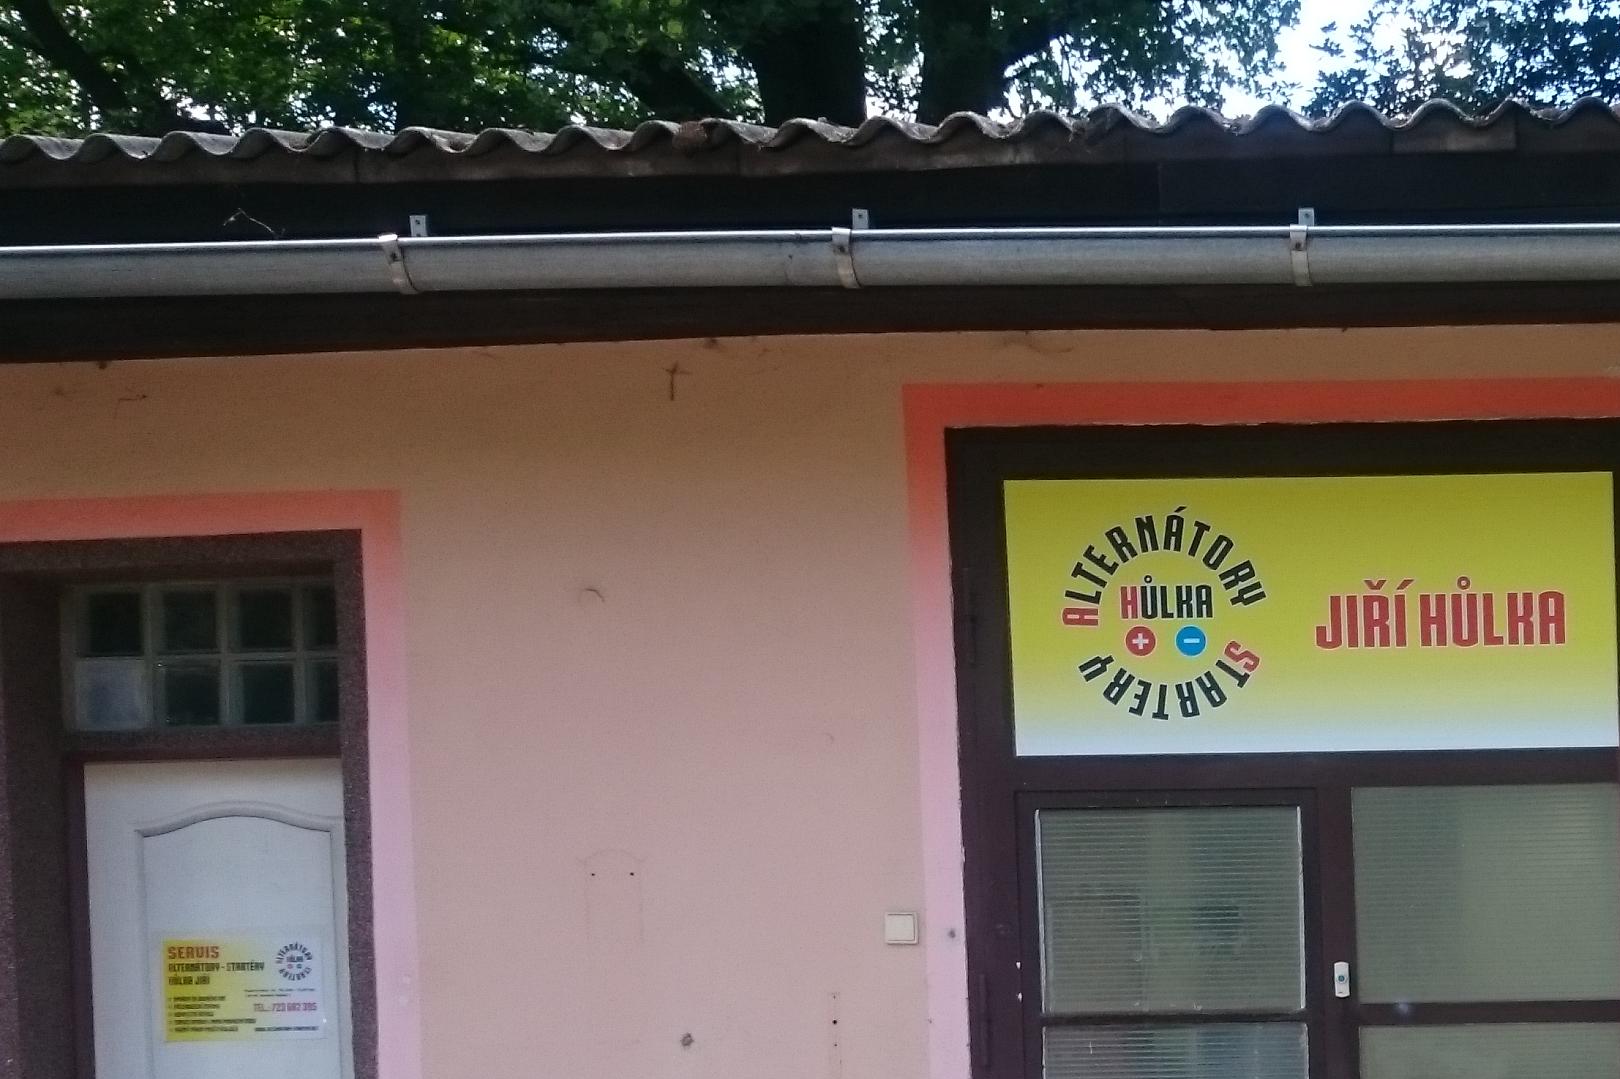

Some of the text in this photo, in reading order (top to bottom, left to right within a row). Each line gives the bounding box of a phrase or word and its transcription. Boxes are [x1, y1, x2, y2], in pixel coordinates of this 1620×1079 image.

[1062, 505, 1267, 626] ALTERNÁTORY
[1120, 575, 1213, 619] HŮLKA
[1315, 576, 1566, 649] JIŘÍ HŮLKA
[1078, 640, 1260, 720] STARTERY
[168, 945, 220, 960] SERVIS
